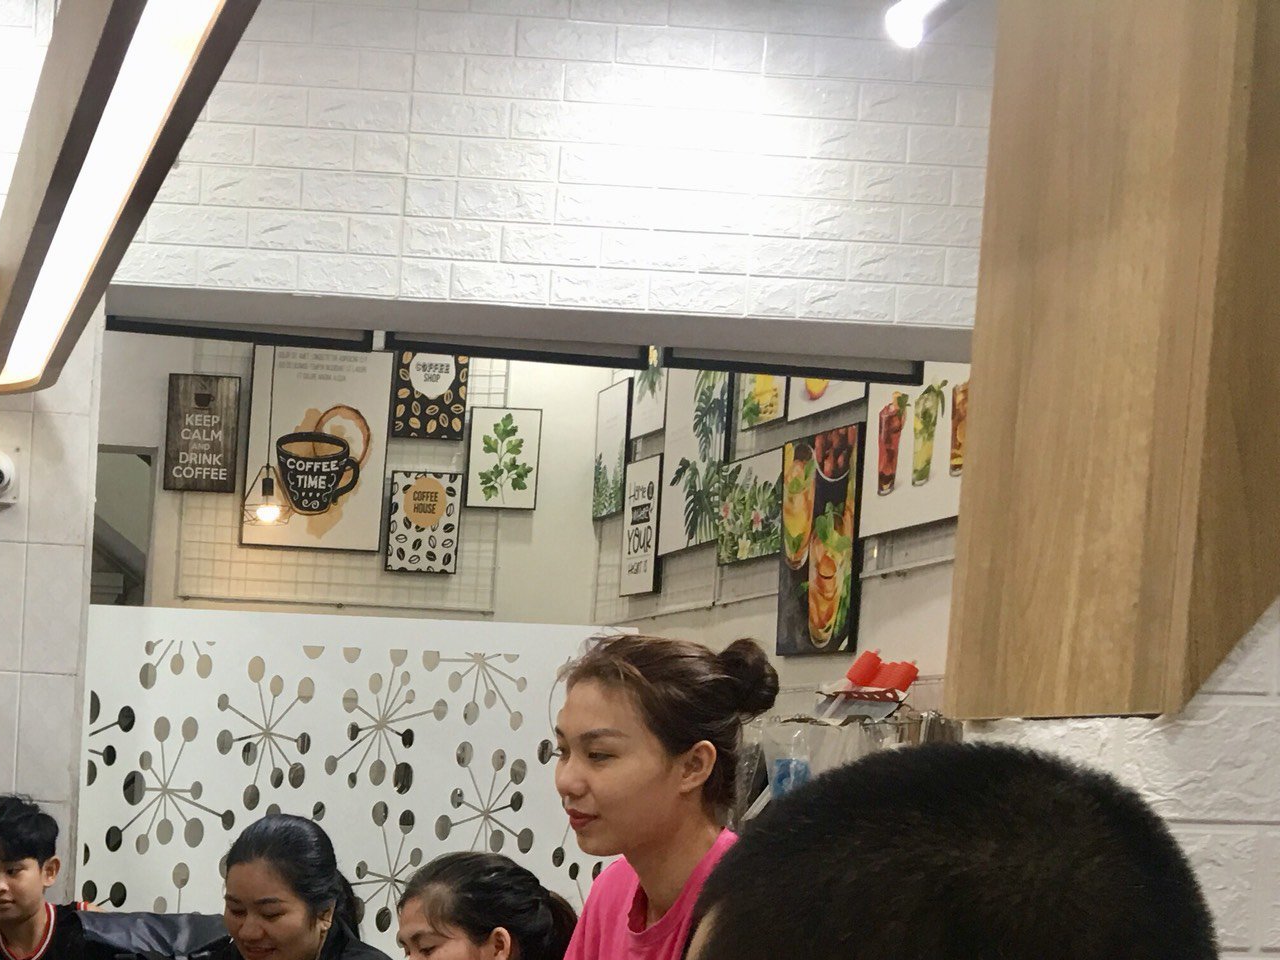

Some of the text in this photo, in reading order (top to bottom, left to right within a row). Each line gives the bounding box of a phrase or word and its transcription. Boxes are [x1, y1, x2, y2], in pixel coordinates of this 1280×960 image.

[415, 362, 450, 374] COFFEE
[423, 373, 441, 383] SHOP
[185, 413, 220, 426] KEEP
[181, 428, 222, 441] CALM
[179, 451, 223, 466] DRINK
[286, 458, 339, 472] COFFEE
[172, 466, 227, 481] COFFEE
[296, 475, 327, 489] TIME
[413, 490, 439, 502] COFFEE
[413, 503, 436, 514] HOUSE
